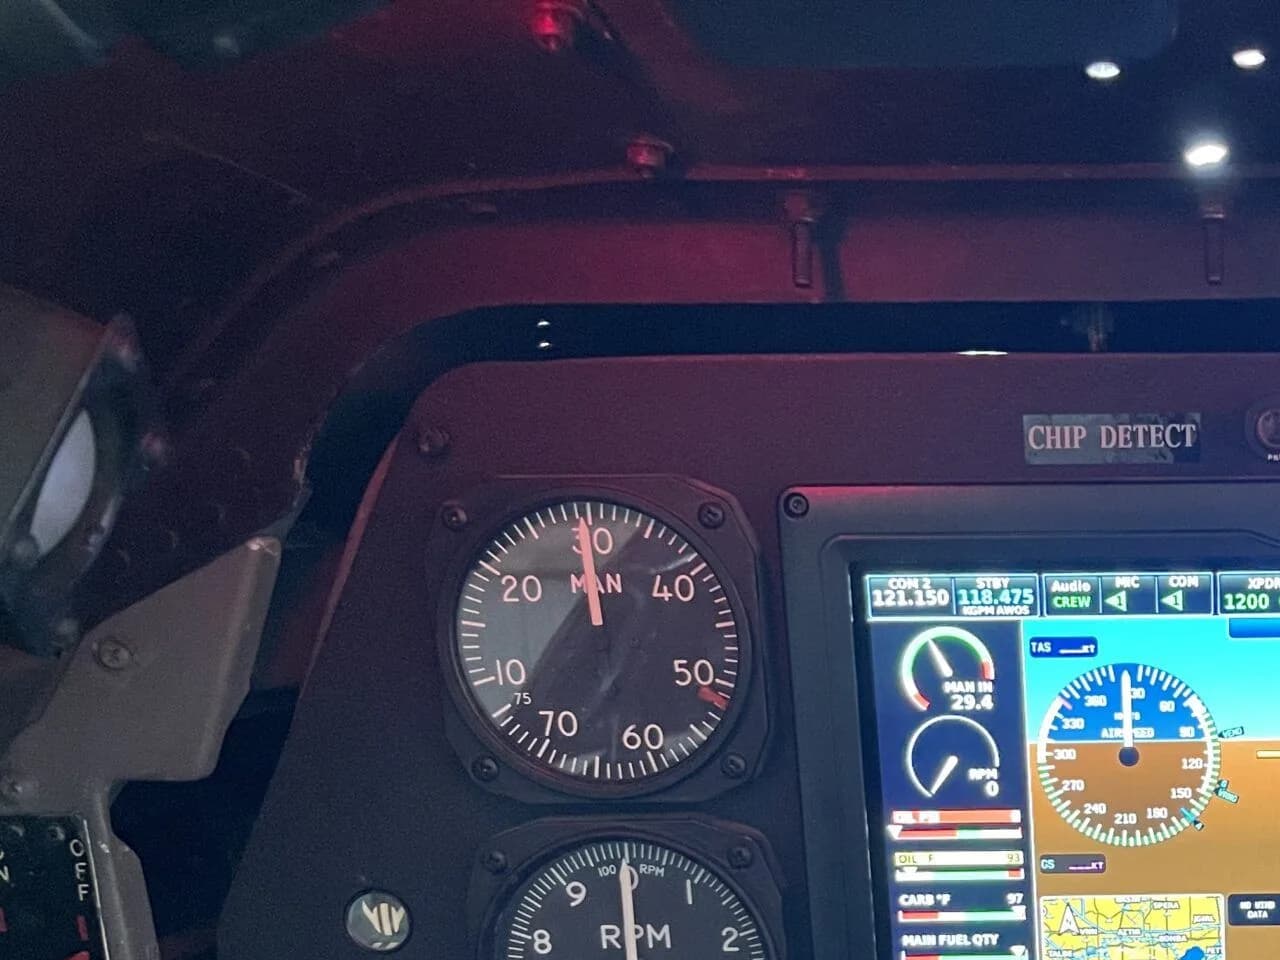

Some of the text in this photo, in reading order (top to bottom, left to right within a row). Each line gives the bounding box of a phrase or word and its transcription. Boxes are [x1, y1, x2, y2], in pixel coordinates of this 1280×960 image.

[1028, 424, 1196, 449] CHIP DETECT
[501, 575, 542, 602] 20
[652, 575, 695, 601] 40
[873, 589, 949, 606] 121.150
[958, 589, 1034, 606] 118.475
[1052, 581, 1090, 593] Audio
[1054, 595, 1091, 608] CREW
[1225, 594, 1269, 610] 1200
[496, 659, 525, 685] 10
[674, 660, 714, 685] 50
[514, 693, 531, 704] 75
[951, 694, 993, 710] 29.4
[539, 711, 577, 736] 70
[623, 724, 664, 749] 60
[599, 865, 616, 876] 100
[640, 864, 664, 877] RPM
[566, 882, 586, 906] 9
[533, 930, 552, 954] 8
[601, 925, 671, 949] RPM
[722, 927, 739, 951] 2
[939, 934, 999, 945] FUEL QTY
